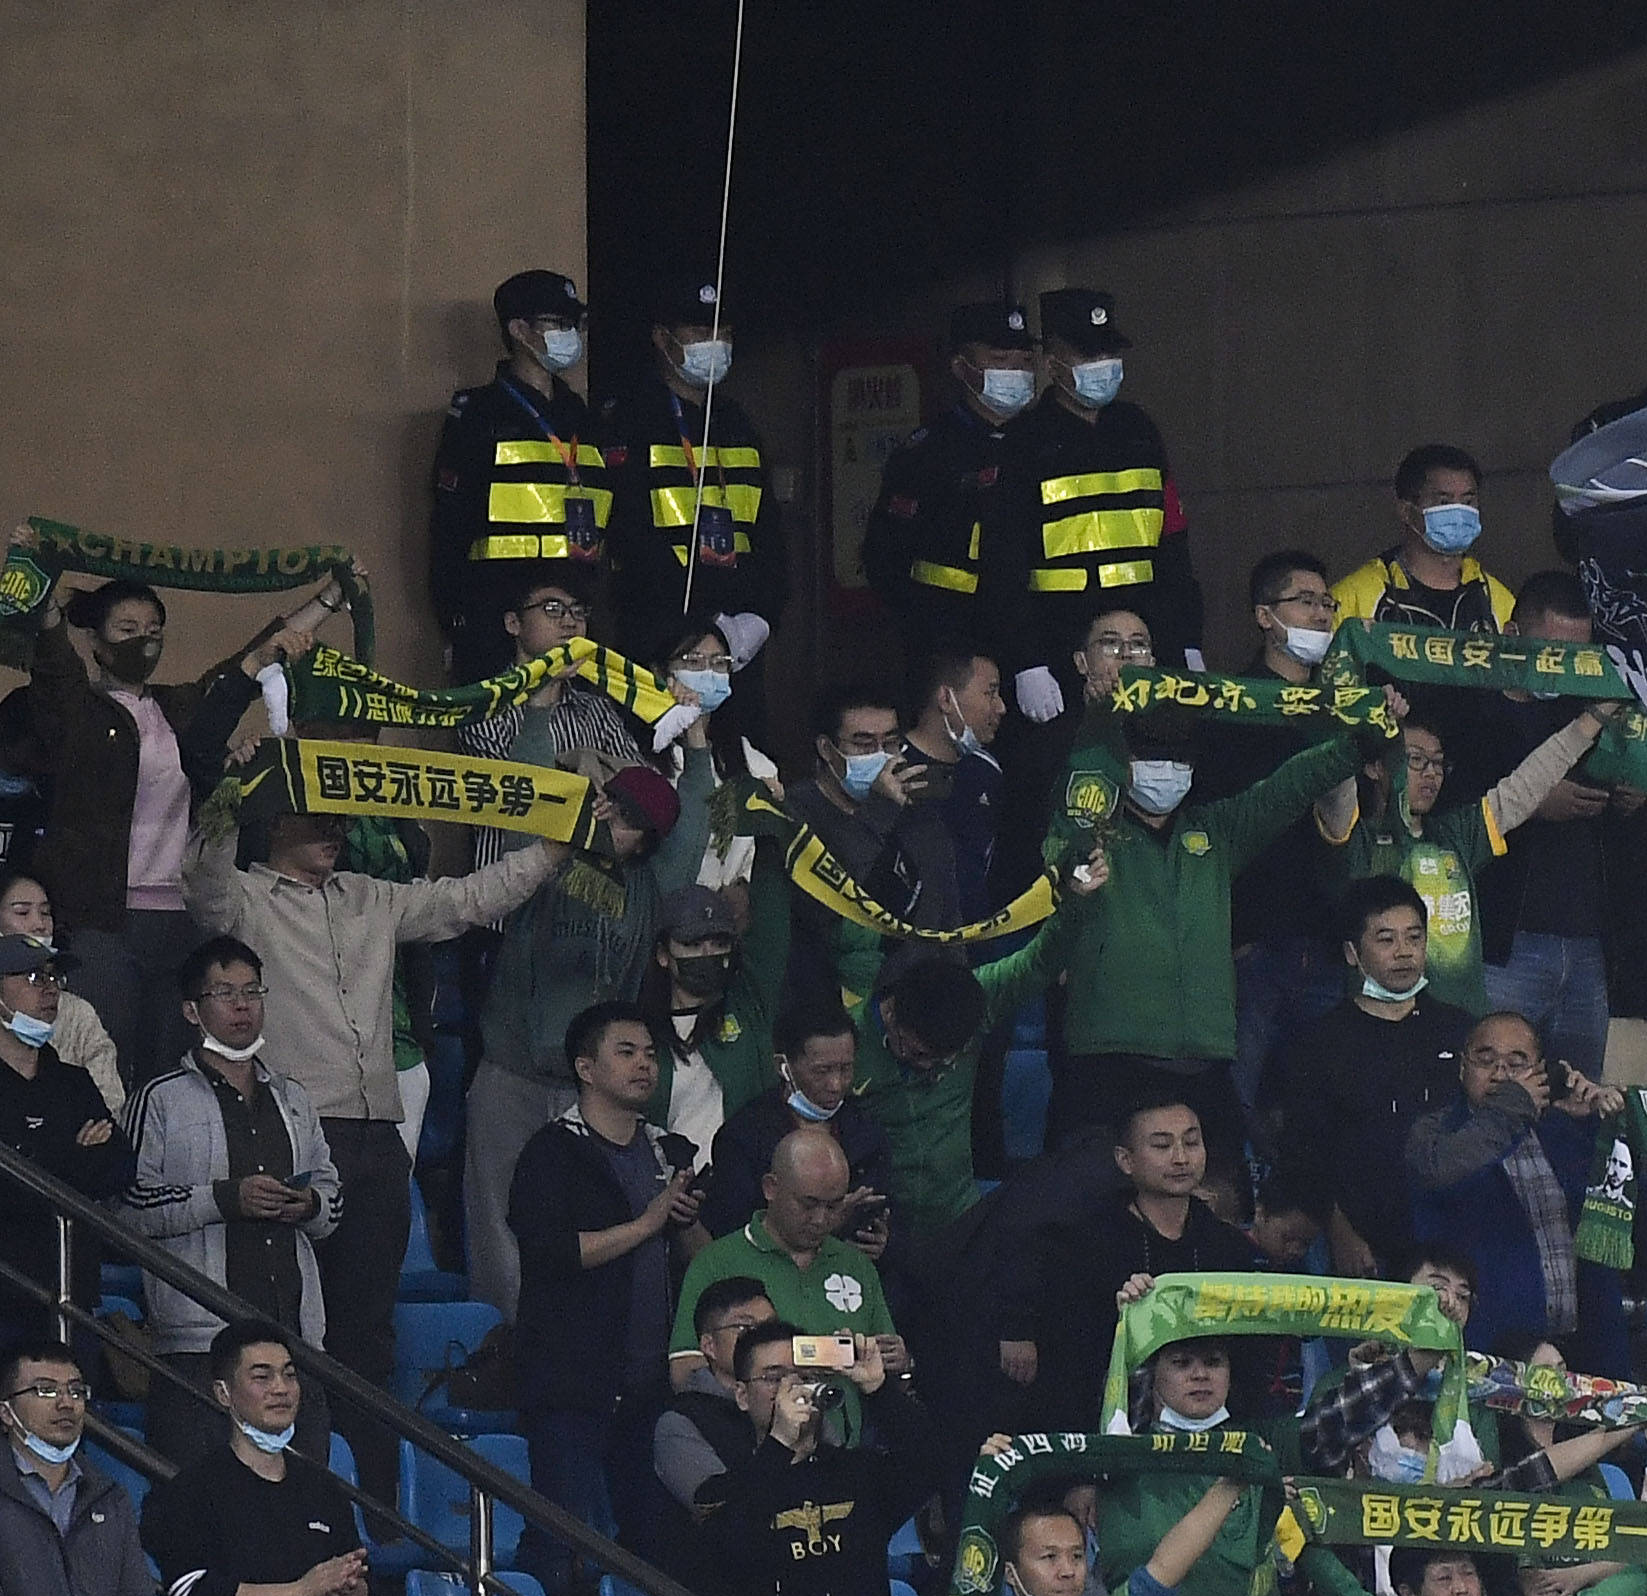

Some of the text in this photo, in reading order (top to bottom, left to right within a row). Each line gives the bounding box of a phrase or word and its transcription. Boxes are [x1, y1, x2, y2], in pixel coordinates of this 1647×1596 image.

[316, 756, 566, 817] 国安永远争第一
[791, 1534, 840, 1560] BOY
